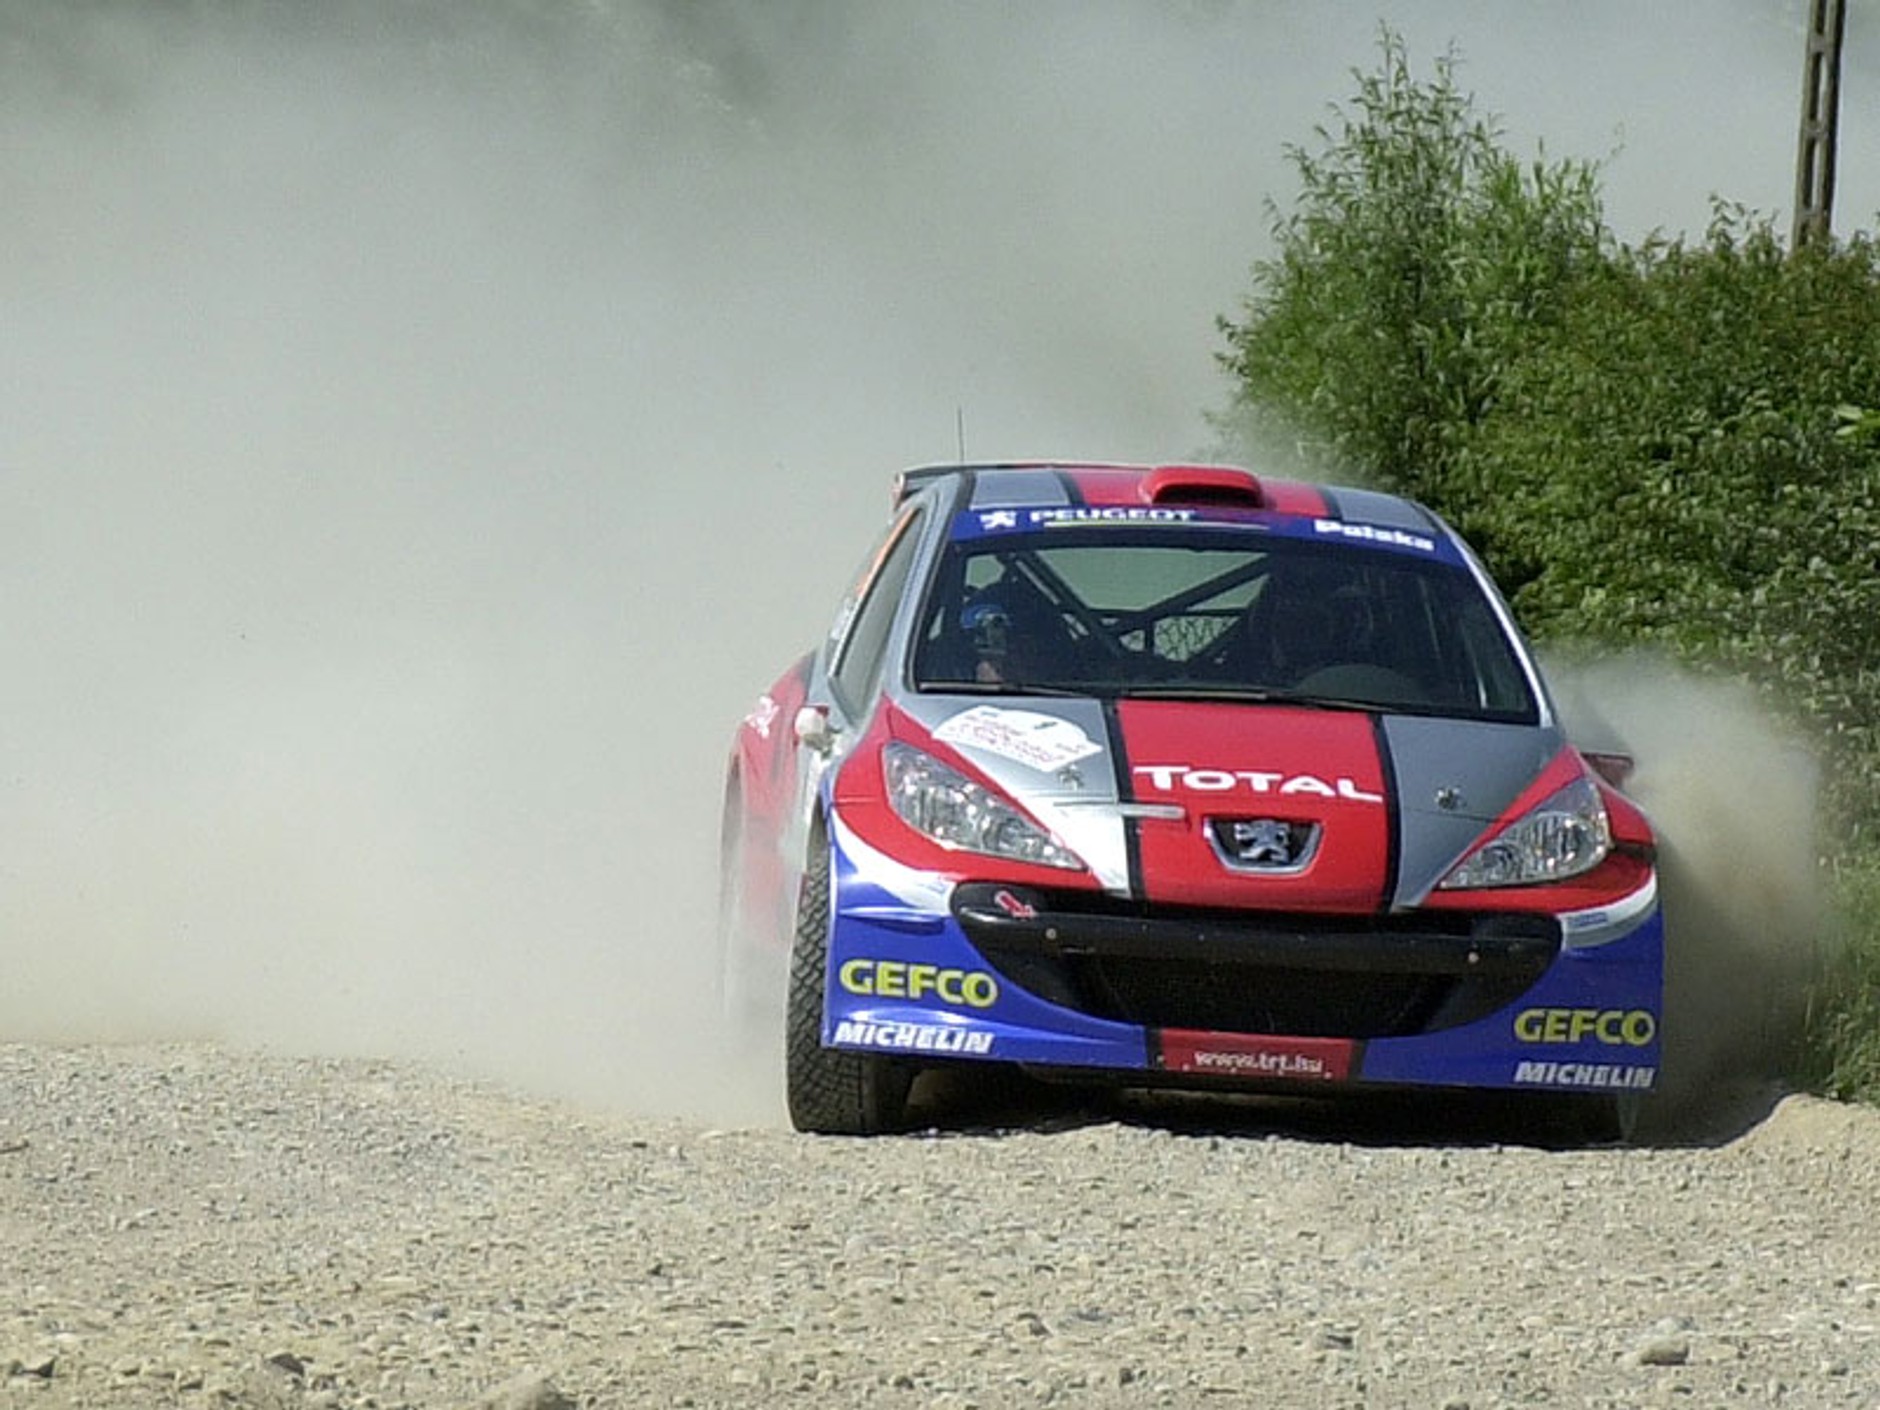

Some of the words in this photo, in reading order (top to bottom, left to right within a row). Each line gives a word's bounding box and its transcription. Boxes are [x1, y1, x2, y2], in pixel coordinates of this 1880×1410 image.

[1030, 508, 1196, 522] PEUGEOT
[1133, 766, 1383, 803] TOTAL
[839, 959, 998, 1007] GEFCO
[834, 1021, 994, 1053] MICHELIN
[1514, 1008, 1655, 1046] GEFCO
[1514, 1061, 1655, 1087] MICHELIN
